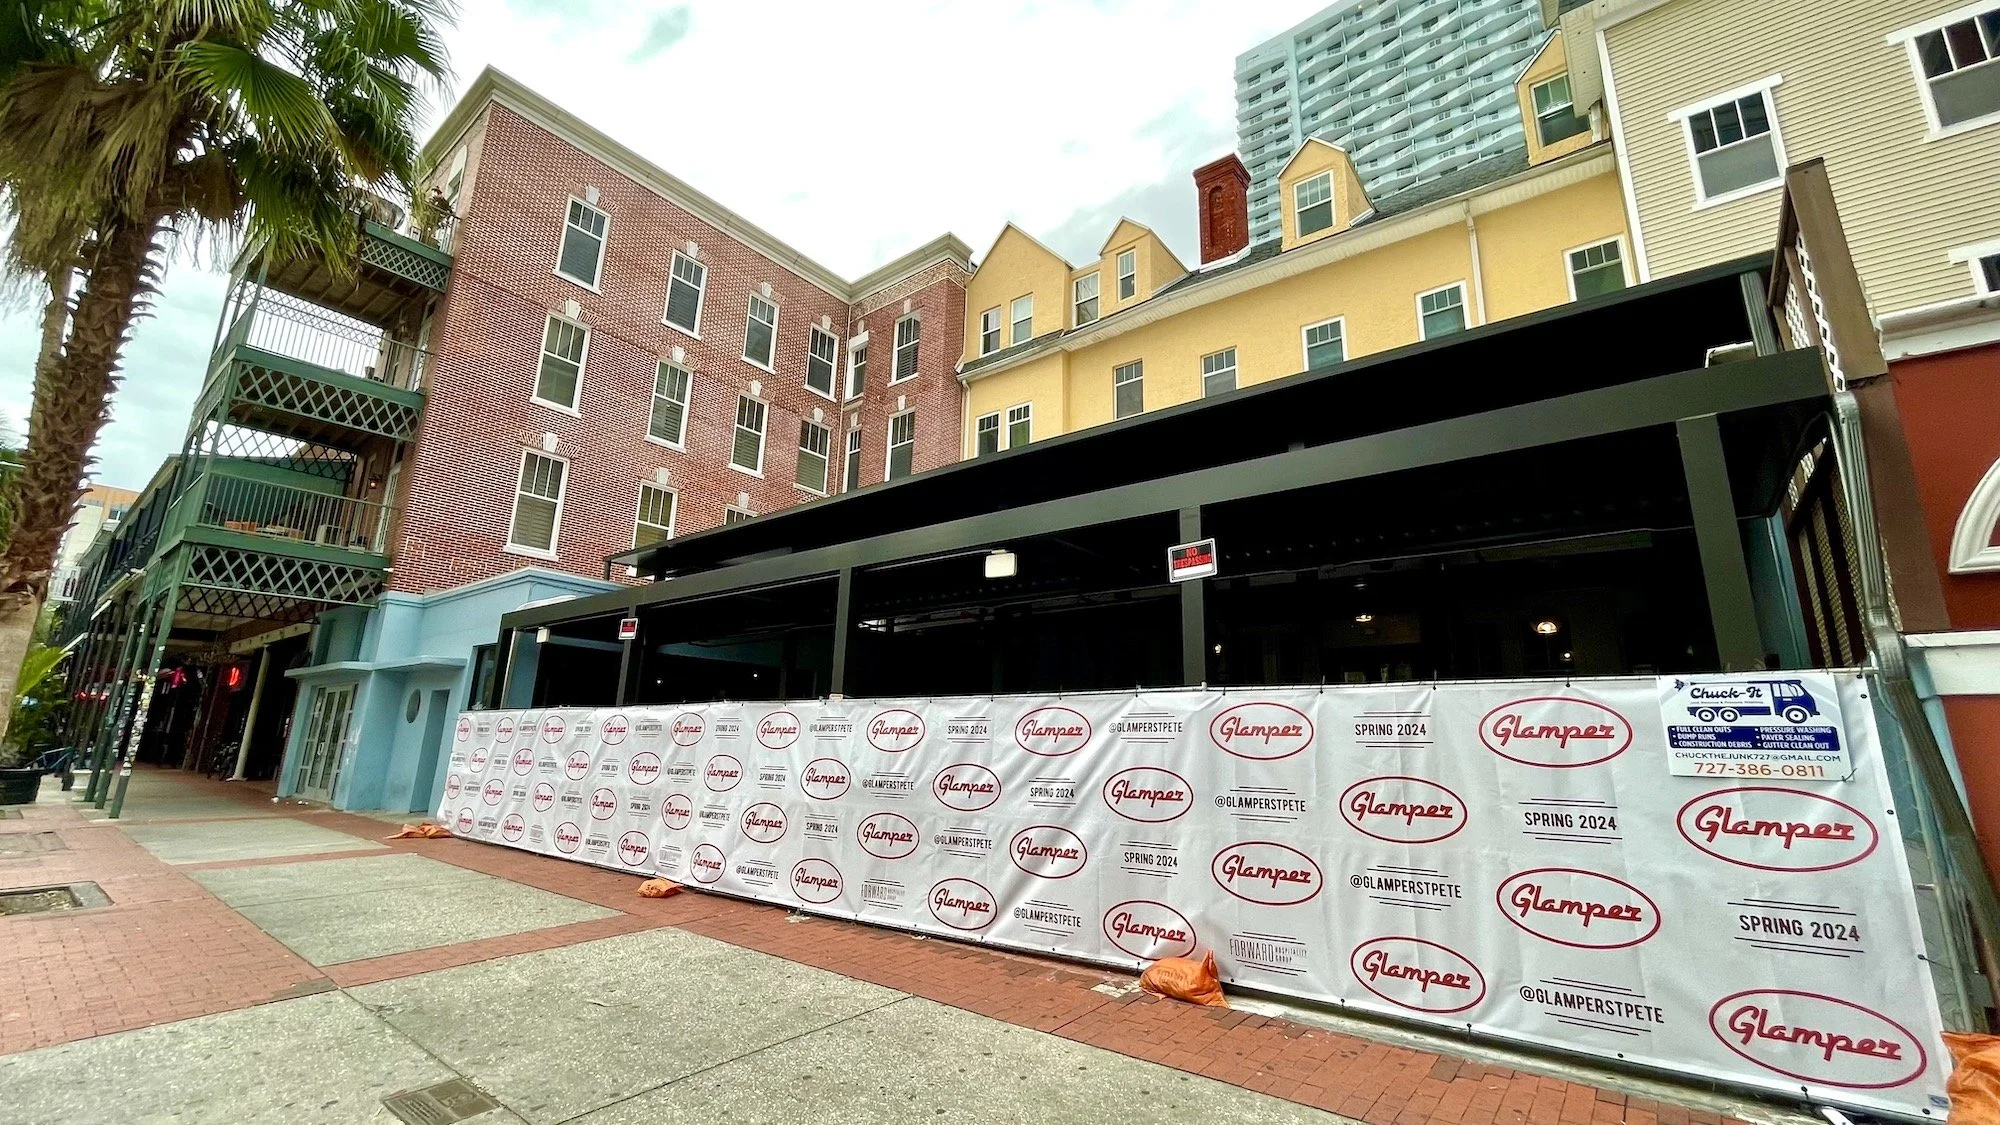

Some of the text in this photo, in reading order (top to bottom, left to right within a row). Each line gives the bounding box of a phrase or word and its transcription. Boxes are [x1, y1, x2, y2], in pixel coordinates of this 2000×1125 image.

[1186, 548, 1198, 557] NO
[1690, 687, 1762, 698] Chuck-It
[761, 721, 796, 740] Glamper
[872, 720, 918, 741] Glamper
[948, 725, 988, 735] SPRING 2024
[1022, 720, 1082, 742] Glamper
[1109, 722, 1182, 733] @GLAMPERSTPETE
[1220, 716, 1302, 744] Glamper
[1355, 724, 1427, 736] SPRING 2024
[1492, 714, 1616, 750] Glamper
[1675, 752, 1840, 762] CHUCKTHEJUNK727@GMAIL.COM
[631, 760, 658, 776] Glamper
[805, 768, 846, 788] Glamper
[1694, 762, 1824, 777] 727-386-0811
[862, 778, 914, 790] @GLAMPERSTPETE
[939, 775, 994, 798] Glamper
[1030, 786, 1074, 798] SPRING 2024
[1112, 780, 1184, 808] Glamper
[665, 802, 690, 820] Glamper
[1214, 795, 1306, 812] @GLAMPERSTPETE
[1350, 791, 1453, 826] Glamper
[745, 811, 782, 832] Glamper
[1524, 811, 1618, 831] SPRING 2024
[1694, 805, 1854, 849] Glamper
[862, 822, 912, 846] Glamper
[934, 836, 992, 850] @GLAMPERSTPETE
[1016, 836, 1078, 864] Glamper
[1124, 852, 1178, 868] SPRING 2024
[794, 868, 838, 892] Glamper
[1222, 854, 1311, 888] Glamper
[1350, 874, 1462, 898] @GLAMPERSTPETE
[934, 888, 990, 916] Glamper
[1511, 883, 1642, 928] Glamper
[1014, 908, 1081, 928] @GLAMPERSTPETE
[1112, 912, 1186, 945] Glamper
[1739, 914, 1861, 942] SPRING 2024
[1230, 938, 1274, 962] FORWARD
[1362, 950, 1470, 993] Glamper
[1520, 984, 1665, 1025] @GLAMPERSTPETE
[1728, 1005, 1902, 1061] Glamper
